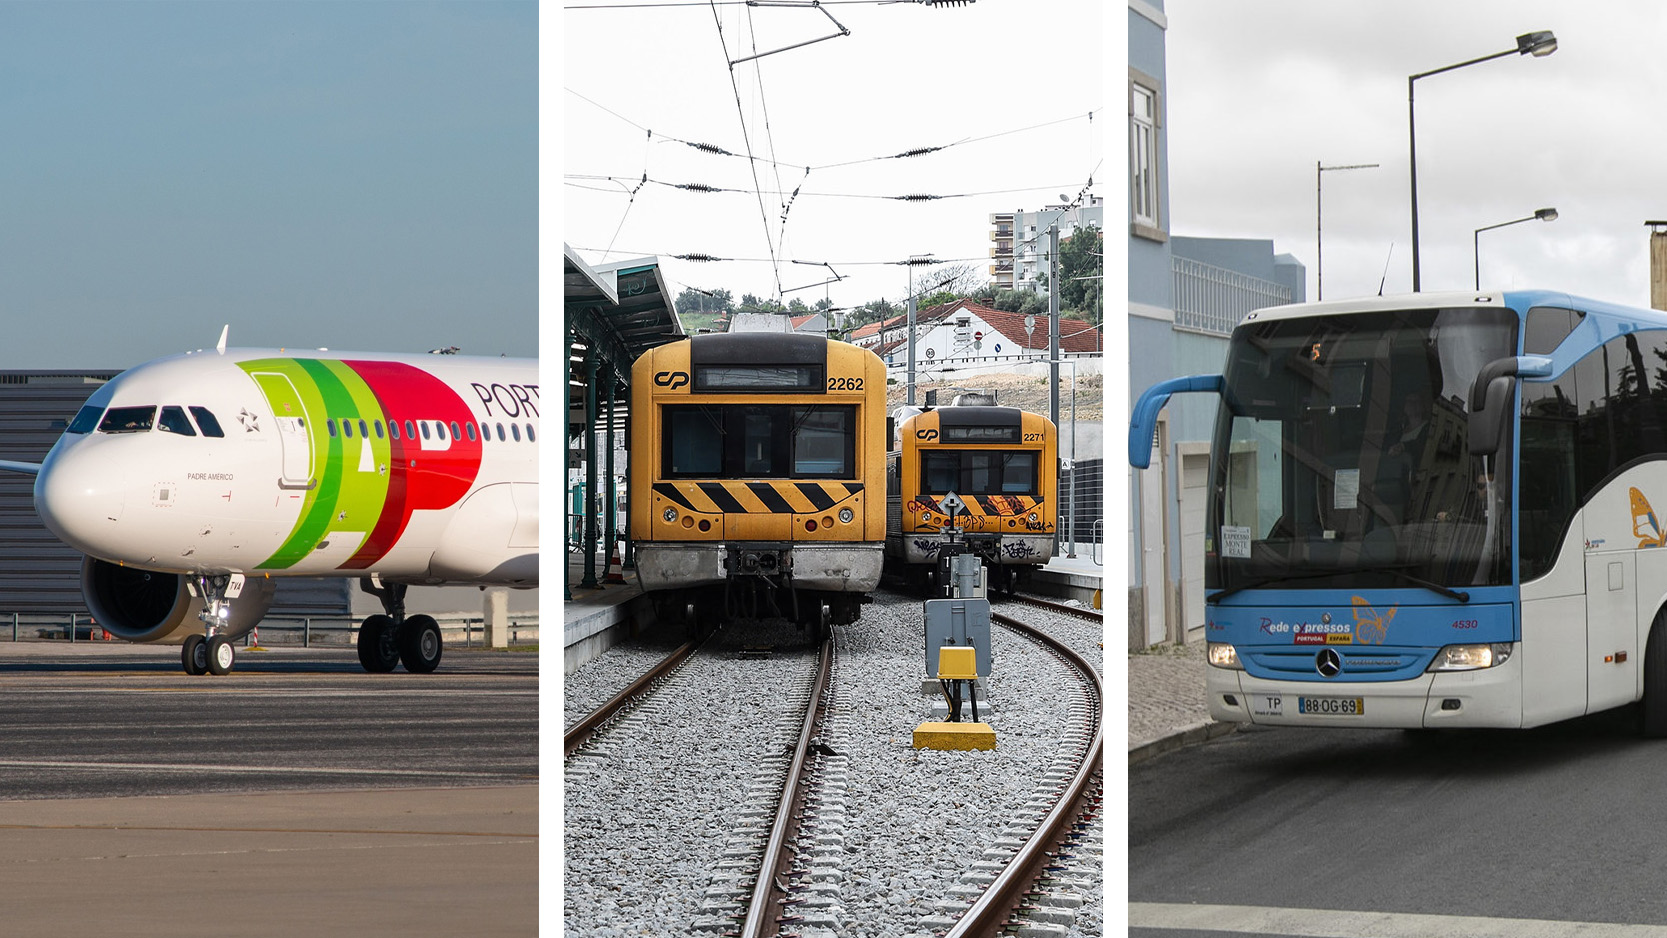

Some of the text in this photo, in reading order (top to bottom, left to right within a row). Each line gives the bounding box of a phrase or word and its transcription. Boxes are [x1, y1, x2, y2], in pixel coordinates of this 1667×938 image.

[827, 377, 864, 391] 2262
[1023, 433, 1045, 442] 2271
[187, 473, 207, 481] PADRE
[1225, 540, 1248, 549] MONTE
[1228, 548, 1245, 556] REAL
[230, 581, 242, 591] TVA
[1260, 617, 1289, 635] Rede
[1452, 619, 1478, 629] 4530
[1266, 697, 1281, 709] TP
